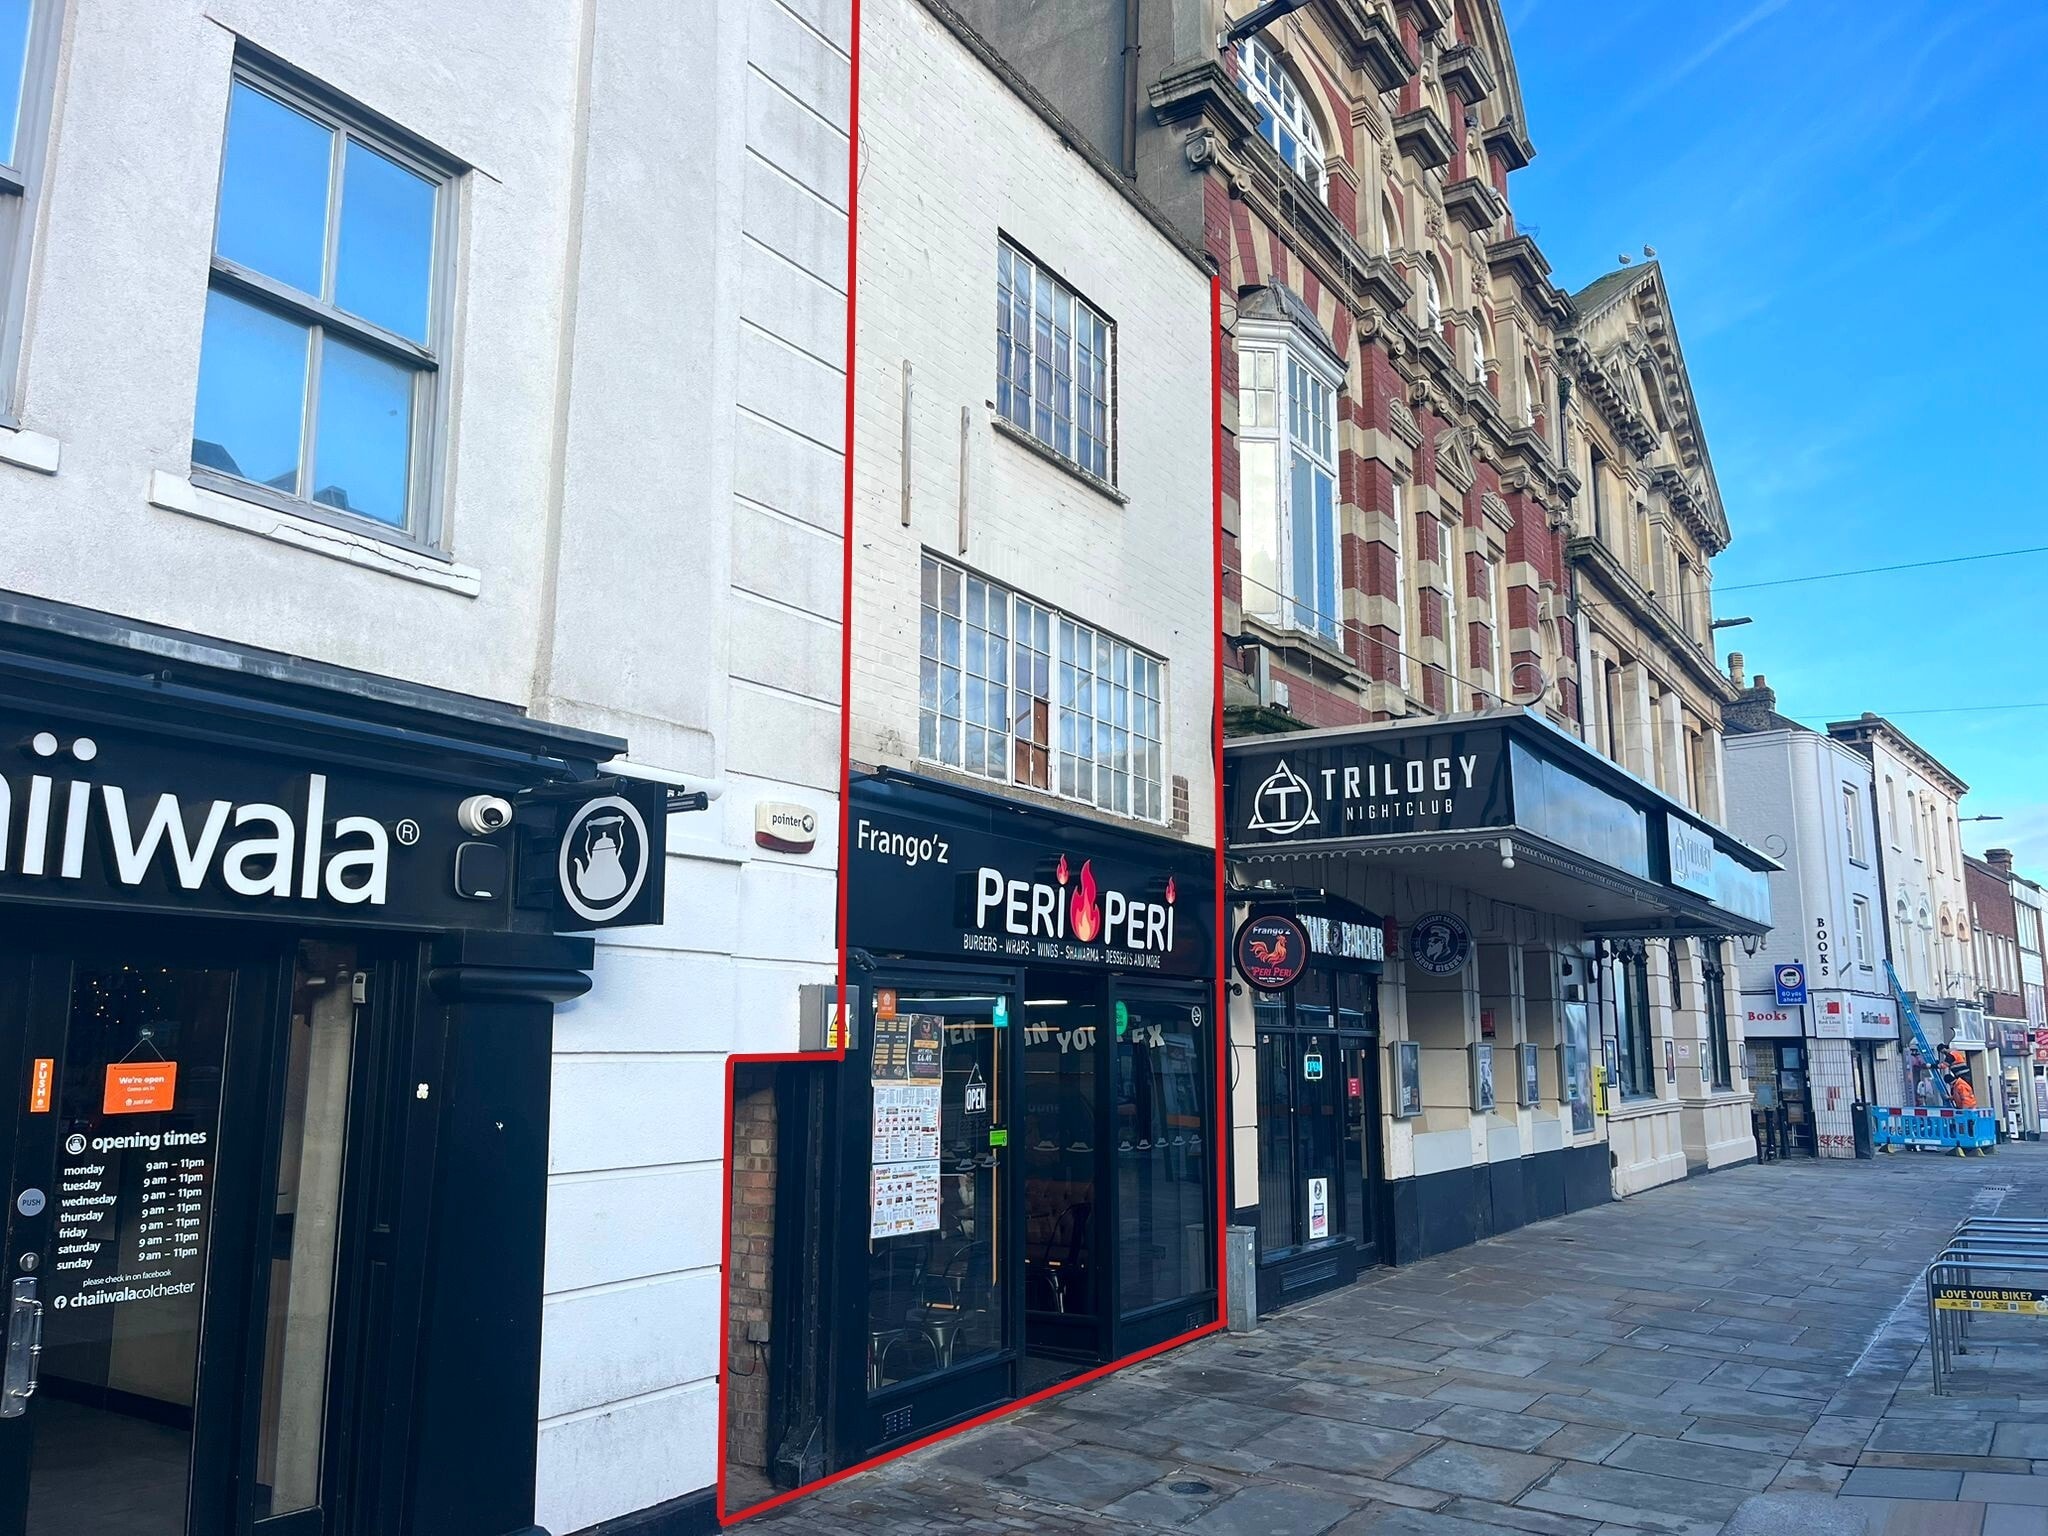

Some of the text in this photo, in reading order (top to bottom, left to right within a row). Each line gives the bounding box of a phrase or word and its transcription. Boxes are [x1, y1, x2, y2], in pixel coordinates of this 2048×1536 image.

[1321, 754, 1477, 800] TRILOGY
[0, 732, 389, 905] iiwala
[772, 813, 802, 827] pointer
[1346, 799, 1453, 821] NIGHTCLUB
[858, 819, 949, 867] Frango'z
[963, 934, 997, 952] BURGERS
[1005, 939, 1030, 956] WRAPS
[1037, 942, 1059, 958] WINGS
[1065, 945, 1099, 962] SHAWARMA
[1105, 950, 1133, 966] DESSERTS
[1134, 954, 1145, 967] AND
[1146, 954, 1161, 969] MORE
[1341, 921, 1384, 961] BARBER
[1816, 917, 1829, 977] BOOKS
[1747, 1011, 1787, 1021] Books
[37, 1062, 48, 1097] PUSH
[119, 1076, 165, 1085] We're open
[966, 1087, 986, 1111] OPEN
[92, 1130, 207, 1153] opening times
[64, 1164, 104, 1176] monday
[180, 1158, 204, 1170] 11pm
[63, 1180, 102, 1192] tuesday
[179, 1173, 203, 1185] 11pm
[61, 1194, 117, 1207] wednesday
[178, 1188, 202, 1199] 11pm
[60, 1210, 104, 1223] thursday
[177, 1203, 201, 1214] 11pm
[59, 1227, 88, 1239] friday
[176, 1217, 200, 1229] 11pm
[58, 1241, 101, 1255] saturday
[174, 1232, 199, 1244] 11pm
[56, 1258, 93, 1271] sunday
[173, 1247, 198, 1259] 11pm
[83, 1276, 104, 1288] please
[105, 1273, 124, 1284] check
[125, 1274, 132, 1282] in
[142, 1269, 172, 1280] facebook
[70, 1281, 195, 1308] chaiiwalacolchester
[1940, 1289, 2033, 1301] LOVE YOUR BIKE?
